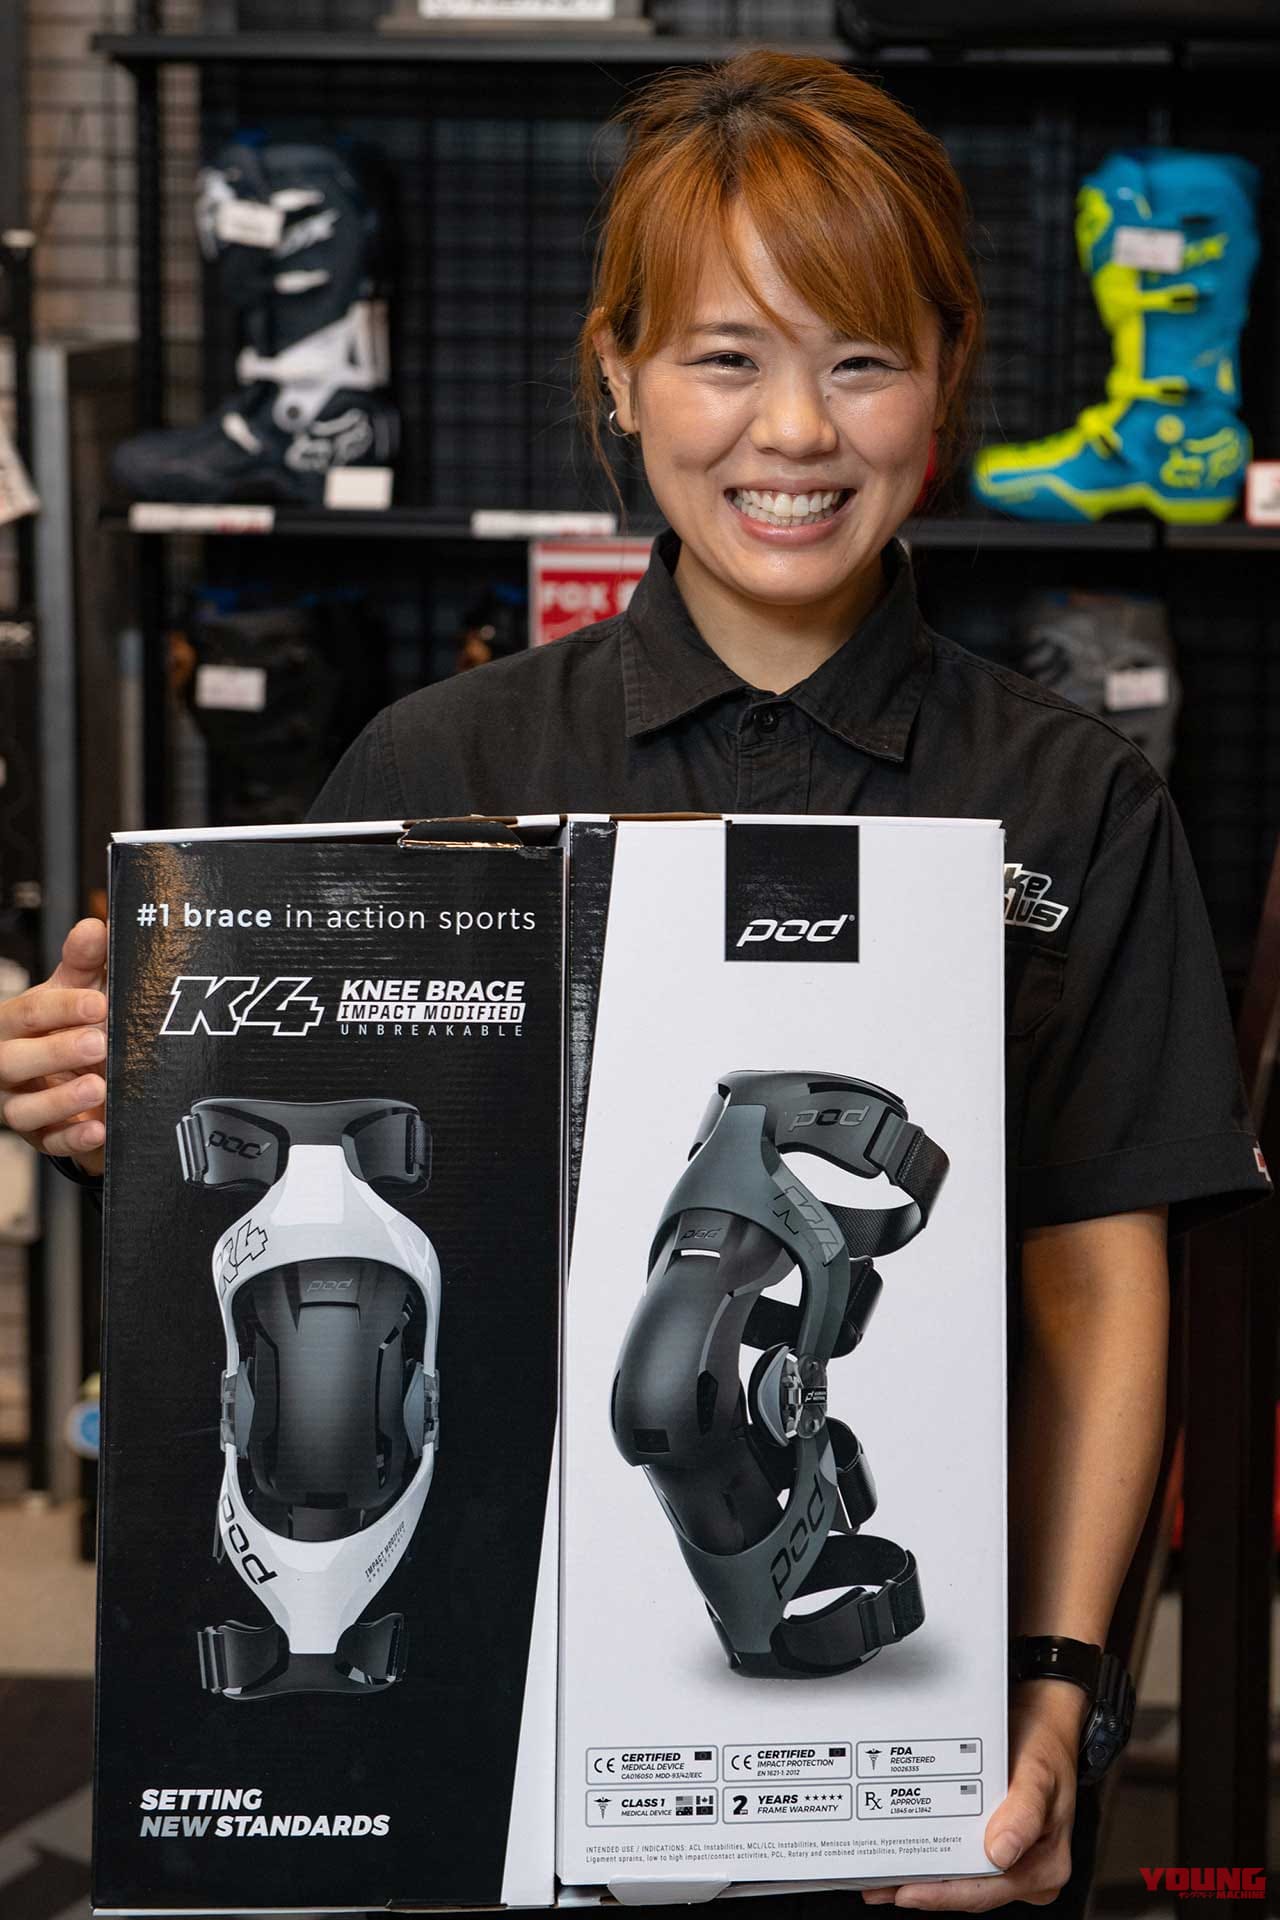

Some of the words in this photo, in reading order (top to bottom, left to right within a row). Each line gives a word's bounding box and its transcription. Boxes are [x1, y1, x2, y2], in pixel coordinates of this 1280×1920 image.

[136, 903, 171, 928] #1
[184, 904, 272, 929] brace
[286, 903, 313, 929] in
[326, 904, 426, 930] action
[438, 906, 537, 935] sports
[736, 914, 849, 947] pod
[340, 979, 420, 1002] KNEE
[425, 980, 525, 1003] BRACE
[159, 976, 325, 1037] K4
[340, 1003, 416, 1021] IMPACT
[423, 1003, 523, 1021] MODIFIED
[340, 1023, 523, 1038] UNBREAKABLE
[787, 1104, 871, 1132] pod
[306, 1278, 354, 1292] pod
[770, 1473, 825, 1601] pod
[621, 1752, 681, 1762] CERTIFIED
[757, 1749, 815, 1759] CERTIFIED
[890, 1746, 912, 1756] FDA
[621, 1763, 656, 1771] MEDICAL
[657, 1762, 685, 1770] DEVICE
[757, 1760, 785, 1768] IMPACT
[787, 1759, 834, 1767] PROTECTION
[890, 1756, 936, 1764] REGISTERED
[140, 1788, 263, 1811] SETTING
[758, 1794, 799, 1805] YEARS
[890, 1788, 921, 1797] PDAC
[621, 1798, 659, 1807] CLASS
[660, 1798, 666, 1807] 1
[733, 1794, 748, 1815] 2
[757, 1806, 787, 1814] FRAME
[789, 1805, 839, 1814] WARRANTY
[890, 1798, 932, 1806] APPROVED
[140, 1815, 212, 1838] NEW
[214, 1814, 391, 1838] STANDARDS
[586, 1845, 619, 1853] INTENDED
[621, 1845, 634, 1853] USE
[689, 1843, 701, 1851] ACL
[747, 1842, 775, 1850] MCL/LCL
[821, 1840, 850, 1848] Meniscus
[933, 1836, 962, 1844] Moderate
[586, 1855, 616, 1864] Ligament
[669, 1854, 683, 1862] high
[788, 1850, 809, 1859] Rotary
[810, 1849, 822, 1857] and
[824, 1848, 855, 1857] combined
[899, 1846, 938, 1855] Prophylactic
